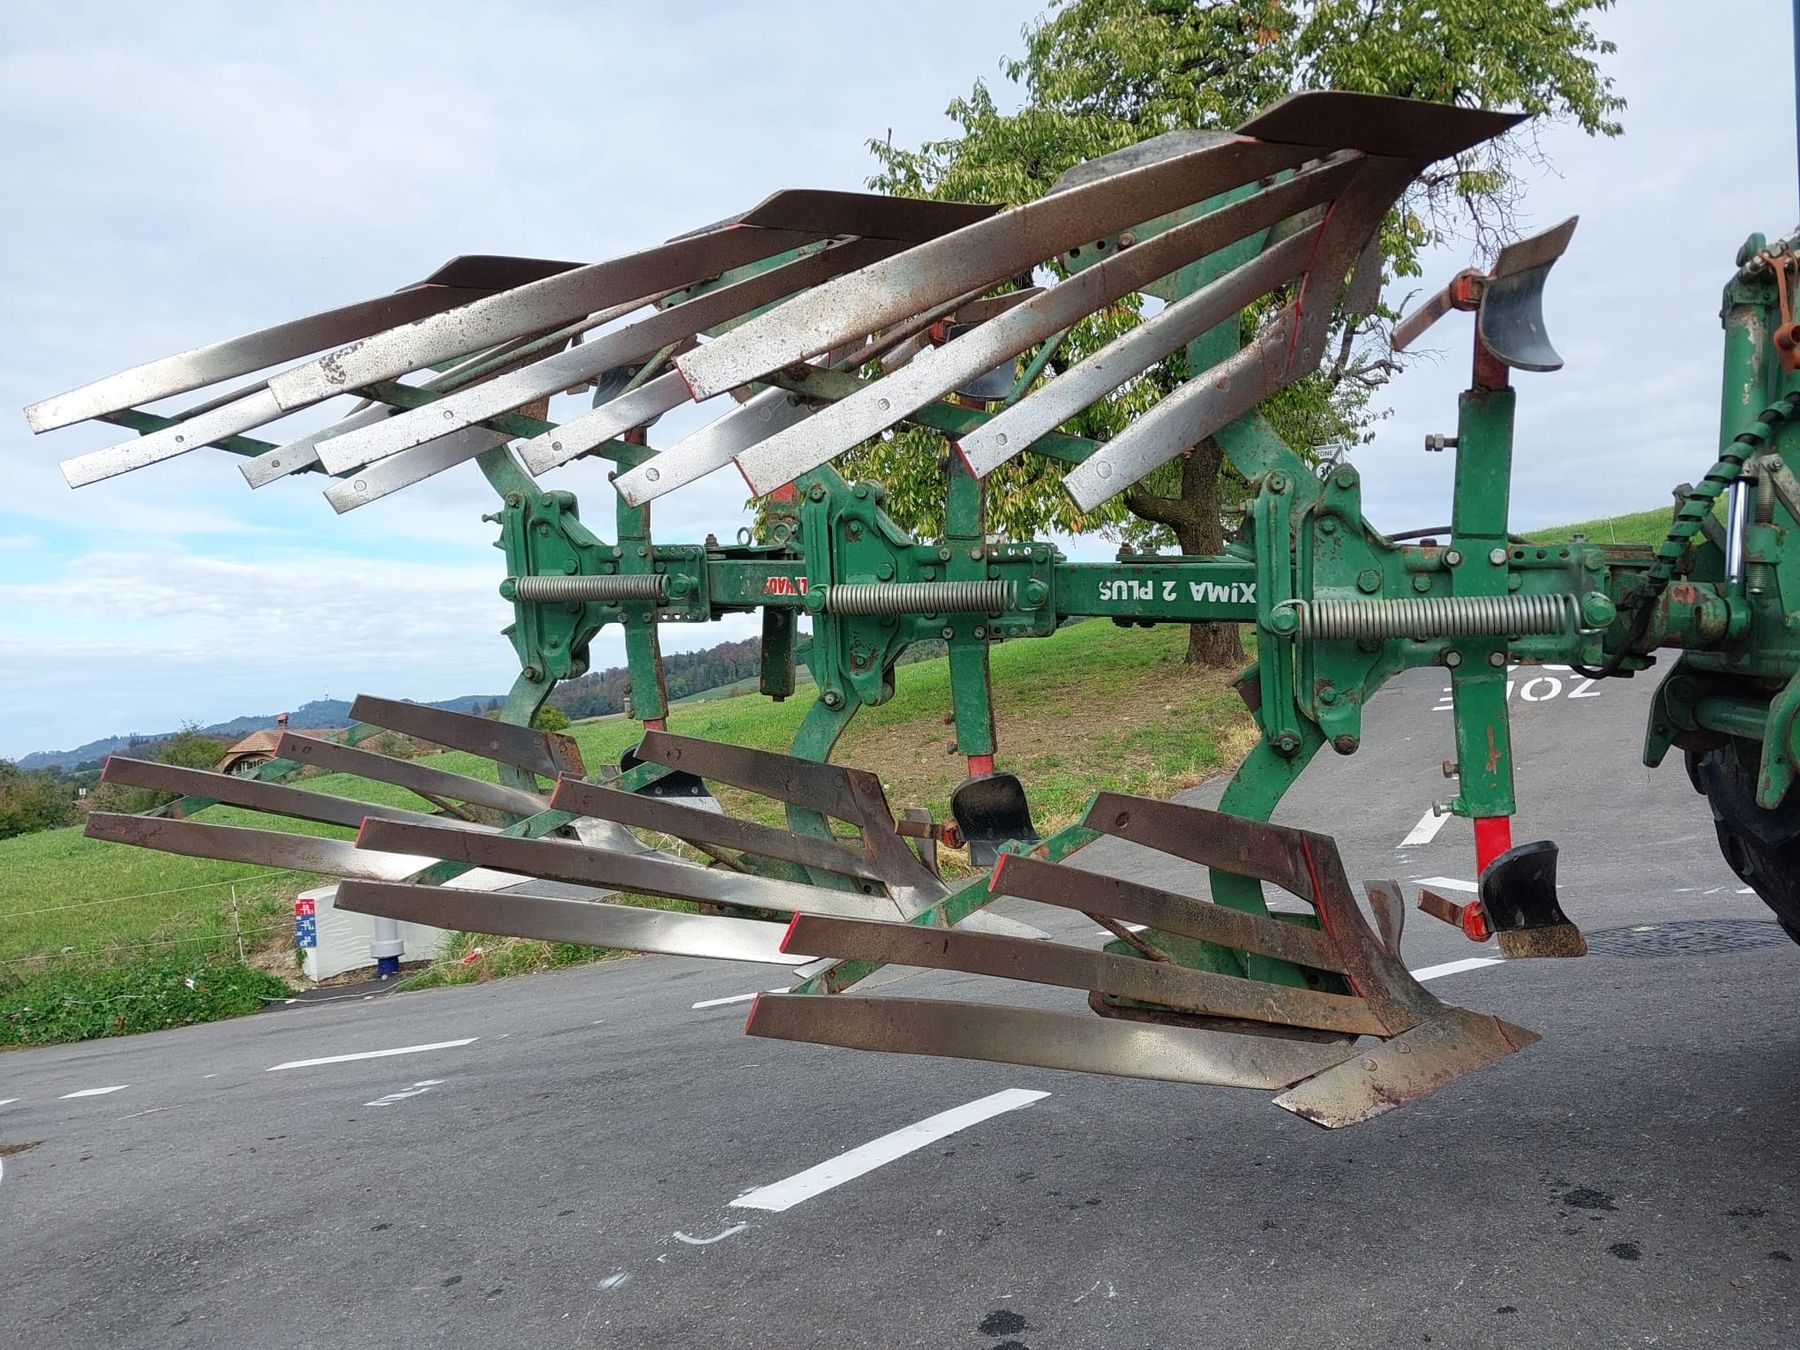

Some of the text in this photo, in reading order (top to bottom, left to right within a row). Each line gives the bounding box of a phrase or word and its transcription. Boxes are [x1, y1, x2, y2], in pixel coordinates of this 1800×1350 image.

[1099, 580, 1257, 603] XIMA 2 PLUS
[1432, 674, 1601, 711] ZOE
